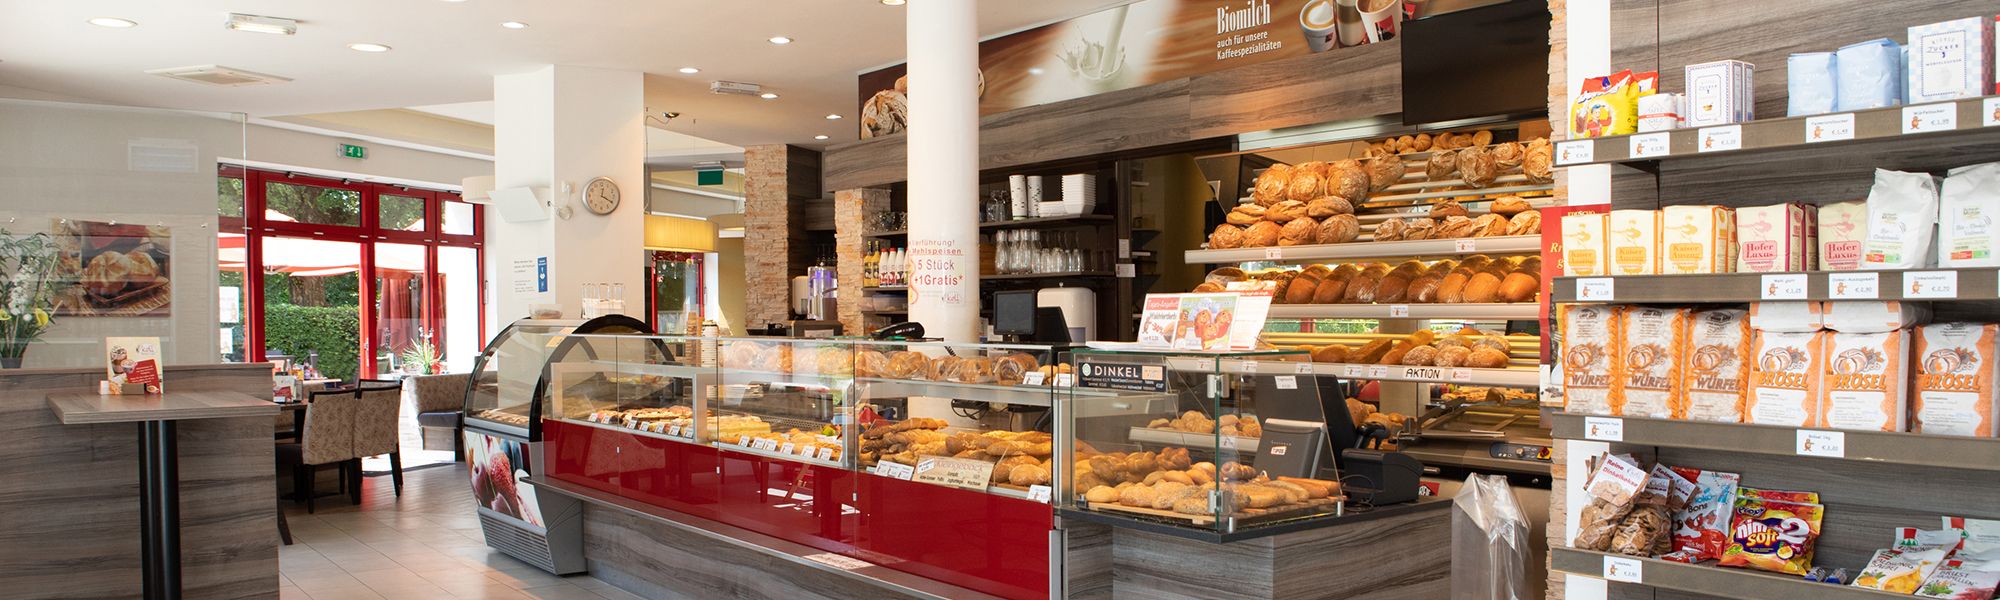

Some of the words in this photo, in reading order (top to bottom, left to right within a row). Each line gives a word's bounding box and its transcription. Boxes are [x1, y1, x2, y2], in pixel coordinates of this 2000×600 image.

[1216, 0, 1271, 35] Biomilch
[1217, 37, 1233, 48] auch
[1233, 34, 1244, 45] für
[1244, 31, 1268, 42] unsere
[1217, 40, 1282, 60] Kaffeespezialitäten
[1746, 243, 1774, 251] Hofer
[1828, 243, 1857, 251] Hofer
[1746, 251, 1774, 259] Luxus
[1828, 251, 1858, 259] Luxus
[917, 259, 923, 270] 5
[926, 258, 955, 270] Stück
[1094, 365, 1139, 378] DINKEL
[1405, 368, 1441, 379] AKTION
[1571, 372, 1610, 386] WÜRFEL
[1631, 372, 1672, 388] WÜRFEL
[1697, 371, 1741, 390] WÜRFEL
[1758, 371, 1809, 388] BRÖSEL
[1832, 372, 1887, 389] BRÖSEL
[1921, 372, 1981, 390] BRÖSEL
[1606, 459, 1624, 470] Reine
[1687, 502, 1708, 513] Bons
[1746, 528, 1779, 547] soft
